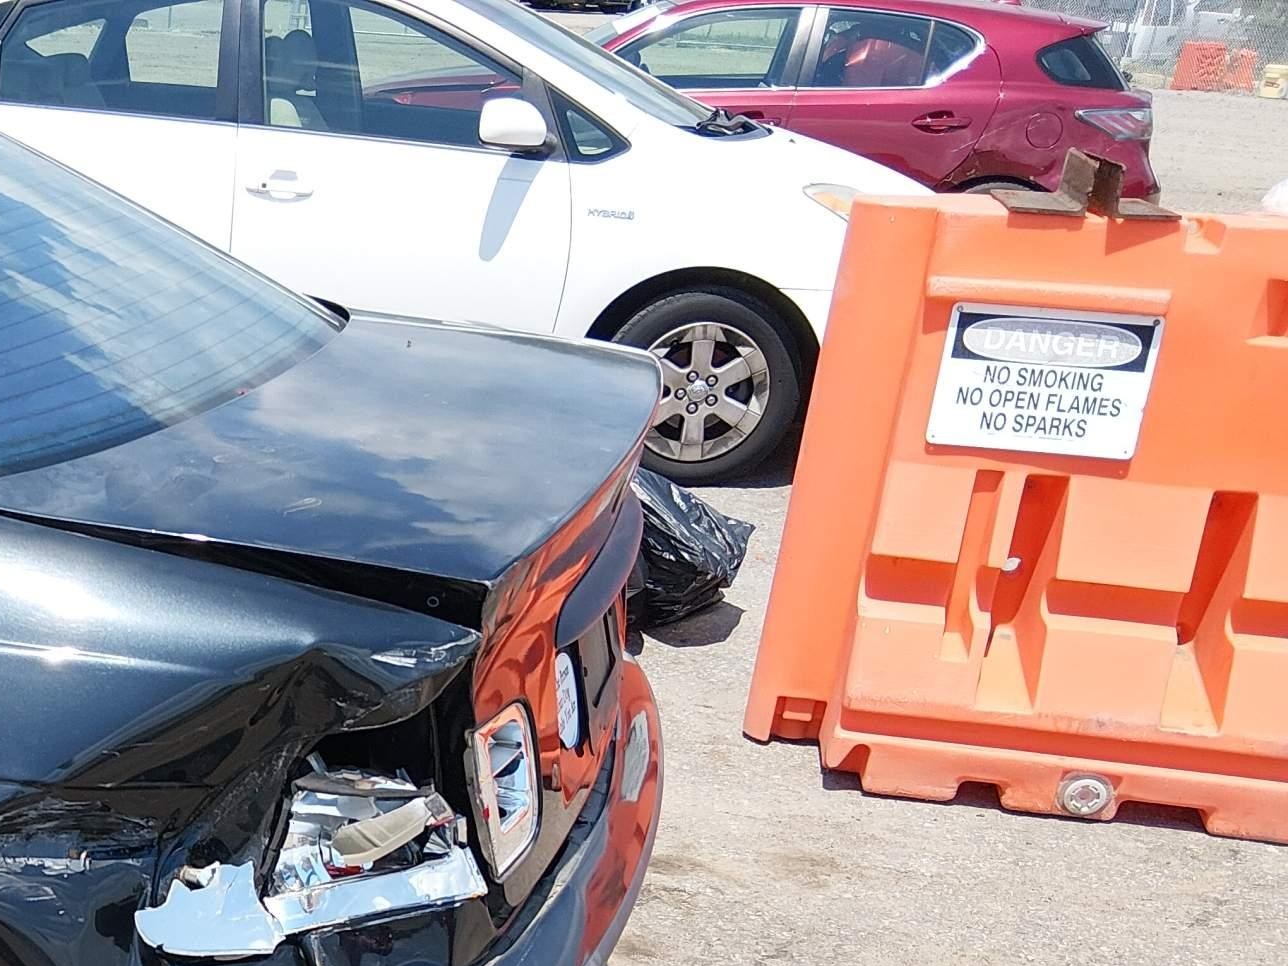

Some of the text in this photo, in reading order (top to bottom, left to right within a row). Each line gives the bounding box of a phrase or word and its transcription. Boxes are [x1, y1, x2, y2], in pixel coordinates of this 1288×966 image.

[983, 327, 1121, 359] DANGER
[984, 365, 1104, 393] NO SMOKING
[956, 387, 1122, 418] NO OPEN FLAMES
[980, 411, 1088, 438] NO SPARKS
